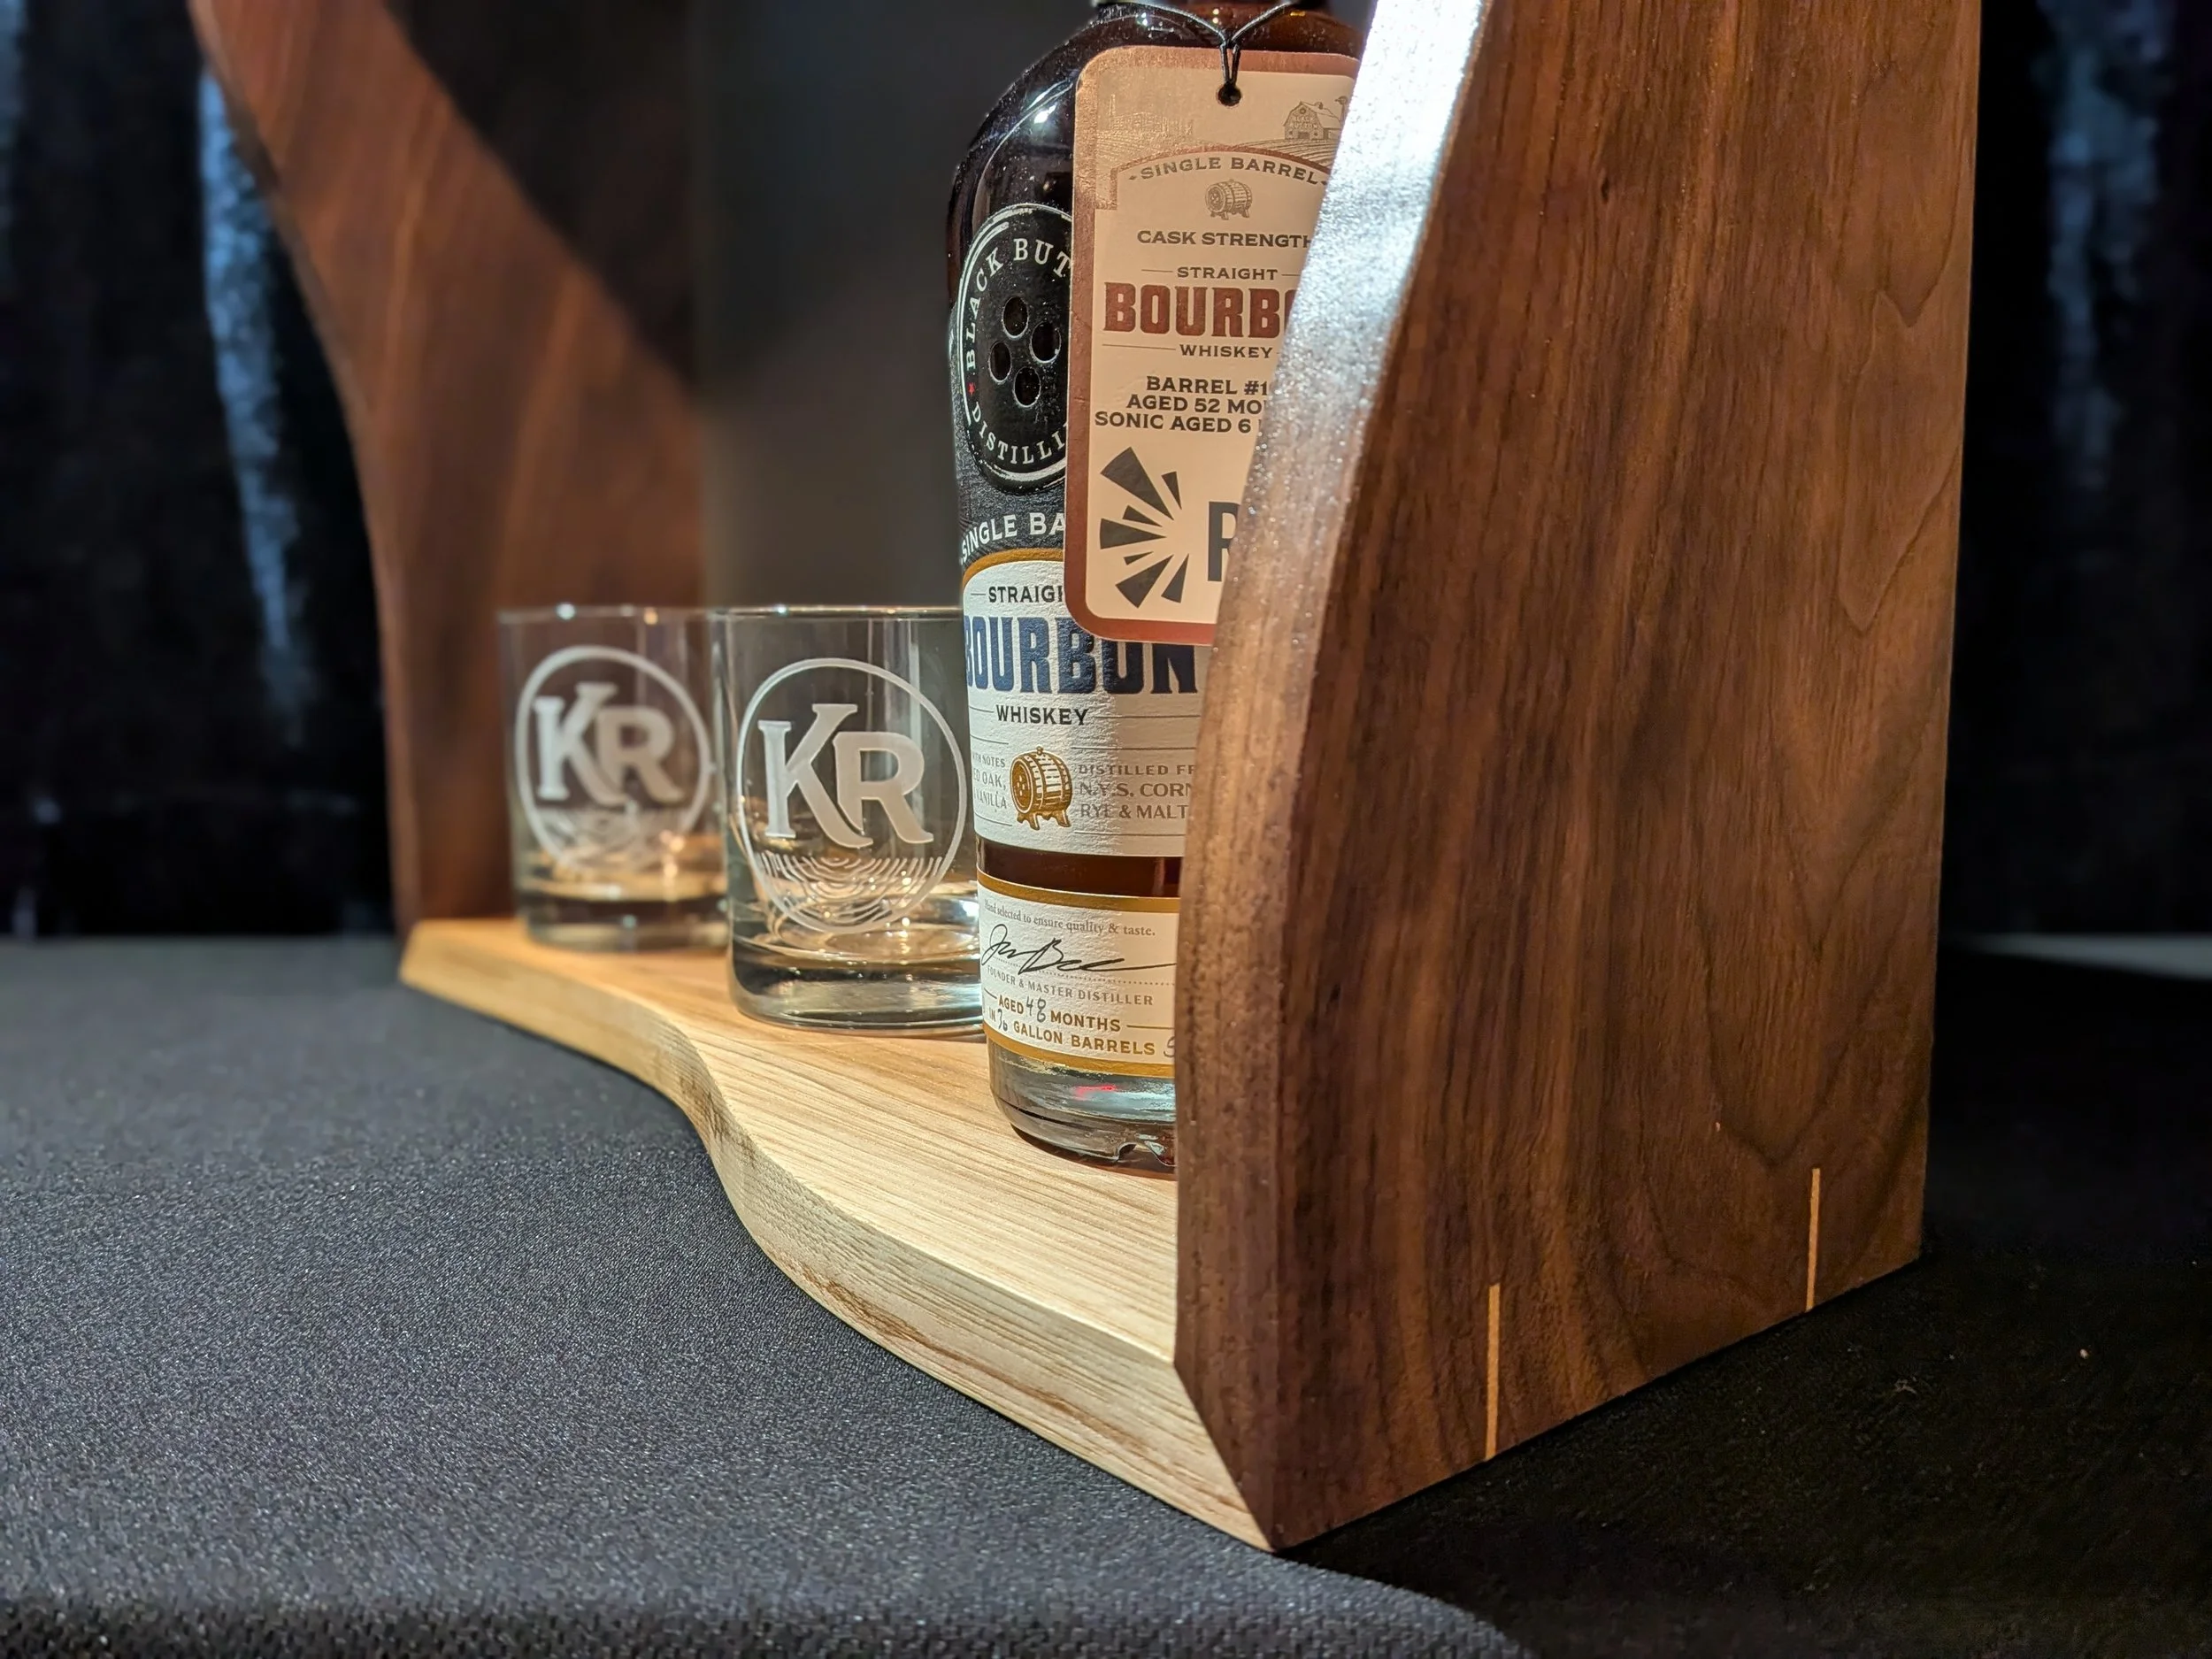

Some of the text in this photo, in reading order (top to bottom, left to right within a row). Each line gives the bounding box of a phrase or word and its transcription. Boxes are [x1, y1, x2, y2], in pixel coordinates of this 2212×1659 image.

[1141, 157, 1318, 185] SINGLE BARREL
[1137, 230, 1196, 245] CASK
[1178, 266, 1279, 280] STRAIGHT
[966, 247, 1003, 372] BLACK
[1179, 344, 1273, 358] WHISKEY
[1147, 375, 1237, 395] BARREL
[1125, 394, 1266, 415] AGED 52 MO
[972, 402, 1068, 465] DISTILLI
[1094, 411, 1164, 429] SONIC
[1169, 416, 1232, 433] AGED
[1238, 419, 1251, 434] 6
[962, 514, 1018, 564] SINGLE
[996, 704, 1089, 726] WHISKEY
[534, 682, 685, 808] KR
[982, 754, 1006, 768] NOTES
[1079, 764, 1169, 776] DISTILLED
[757, 703, 934, 849] KR
[982, 772, 1006, 790] OAK,
[1080, 803, 1112, 818] RYE
[1119, 804, 1131, 819] &
[1023, 914, 1032, 923] to
[1033, 917, 1064, 929] ensure
[1109, 923, 1118, 934] &
[1124, 926, 1156, 936] taste.
[1018, 979, 1025, 988] &
[1028, 980, 1072, 998] MASTER
[1078, 989, 1154, 1005] DISTILLER
[998, 995, 1024, 1015] AGED
[1050, 1010, 1121, 1033] MONTHS
[1013, 1021, 1063, 1045] GALLON
[1071, 1034, 1155, 1056] BARRELS
